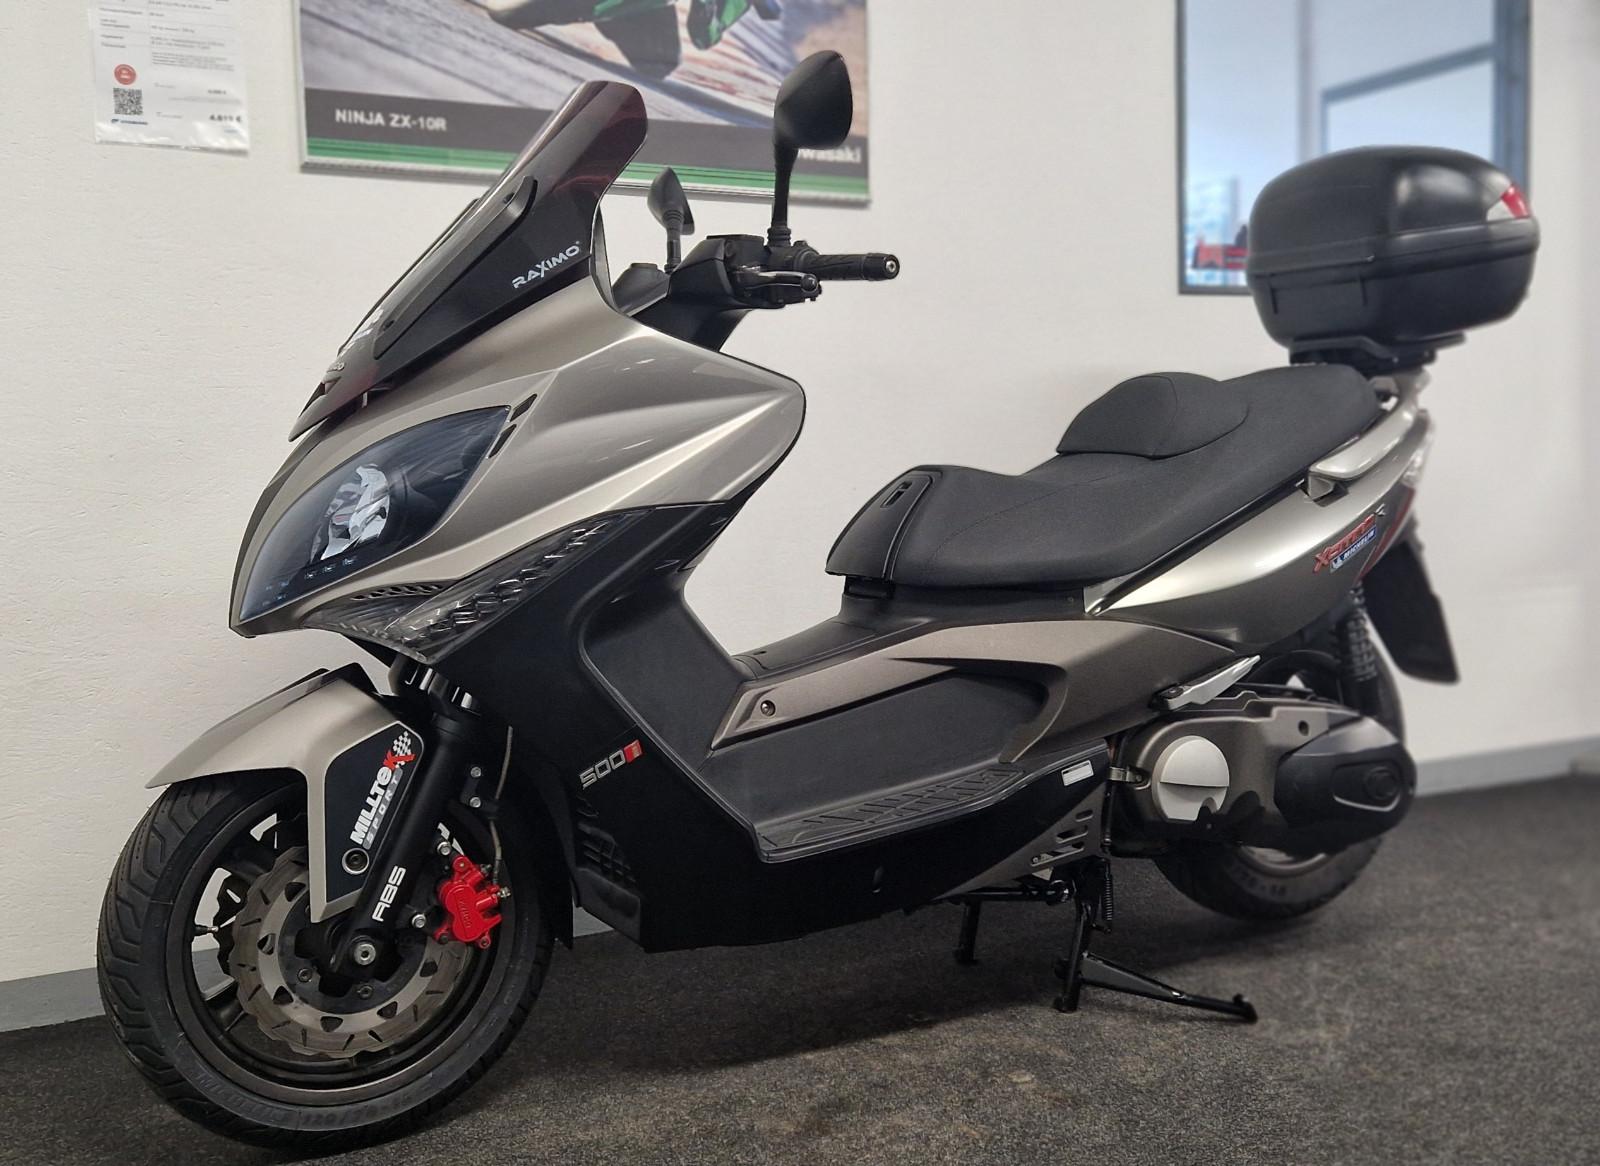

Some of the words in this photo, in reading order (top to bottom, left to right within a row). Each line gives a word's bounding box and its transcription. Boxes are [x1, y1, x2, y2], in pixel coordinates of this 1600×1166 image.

[335, 108, 386, 127] NINJA
[388, 112, 447, 131] ZX-10R
[798, 145, 862, 163] wasaki
[512, 244, 580, 289] RAXIMO
[365, 773, 402, 846] SPORT
[371, 865, 407, 922] ABS
